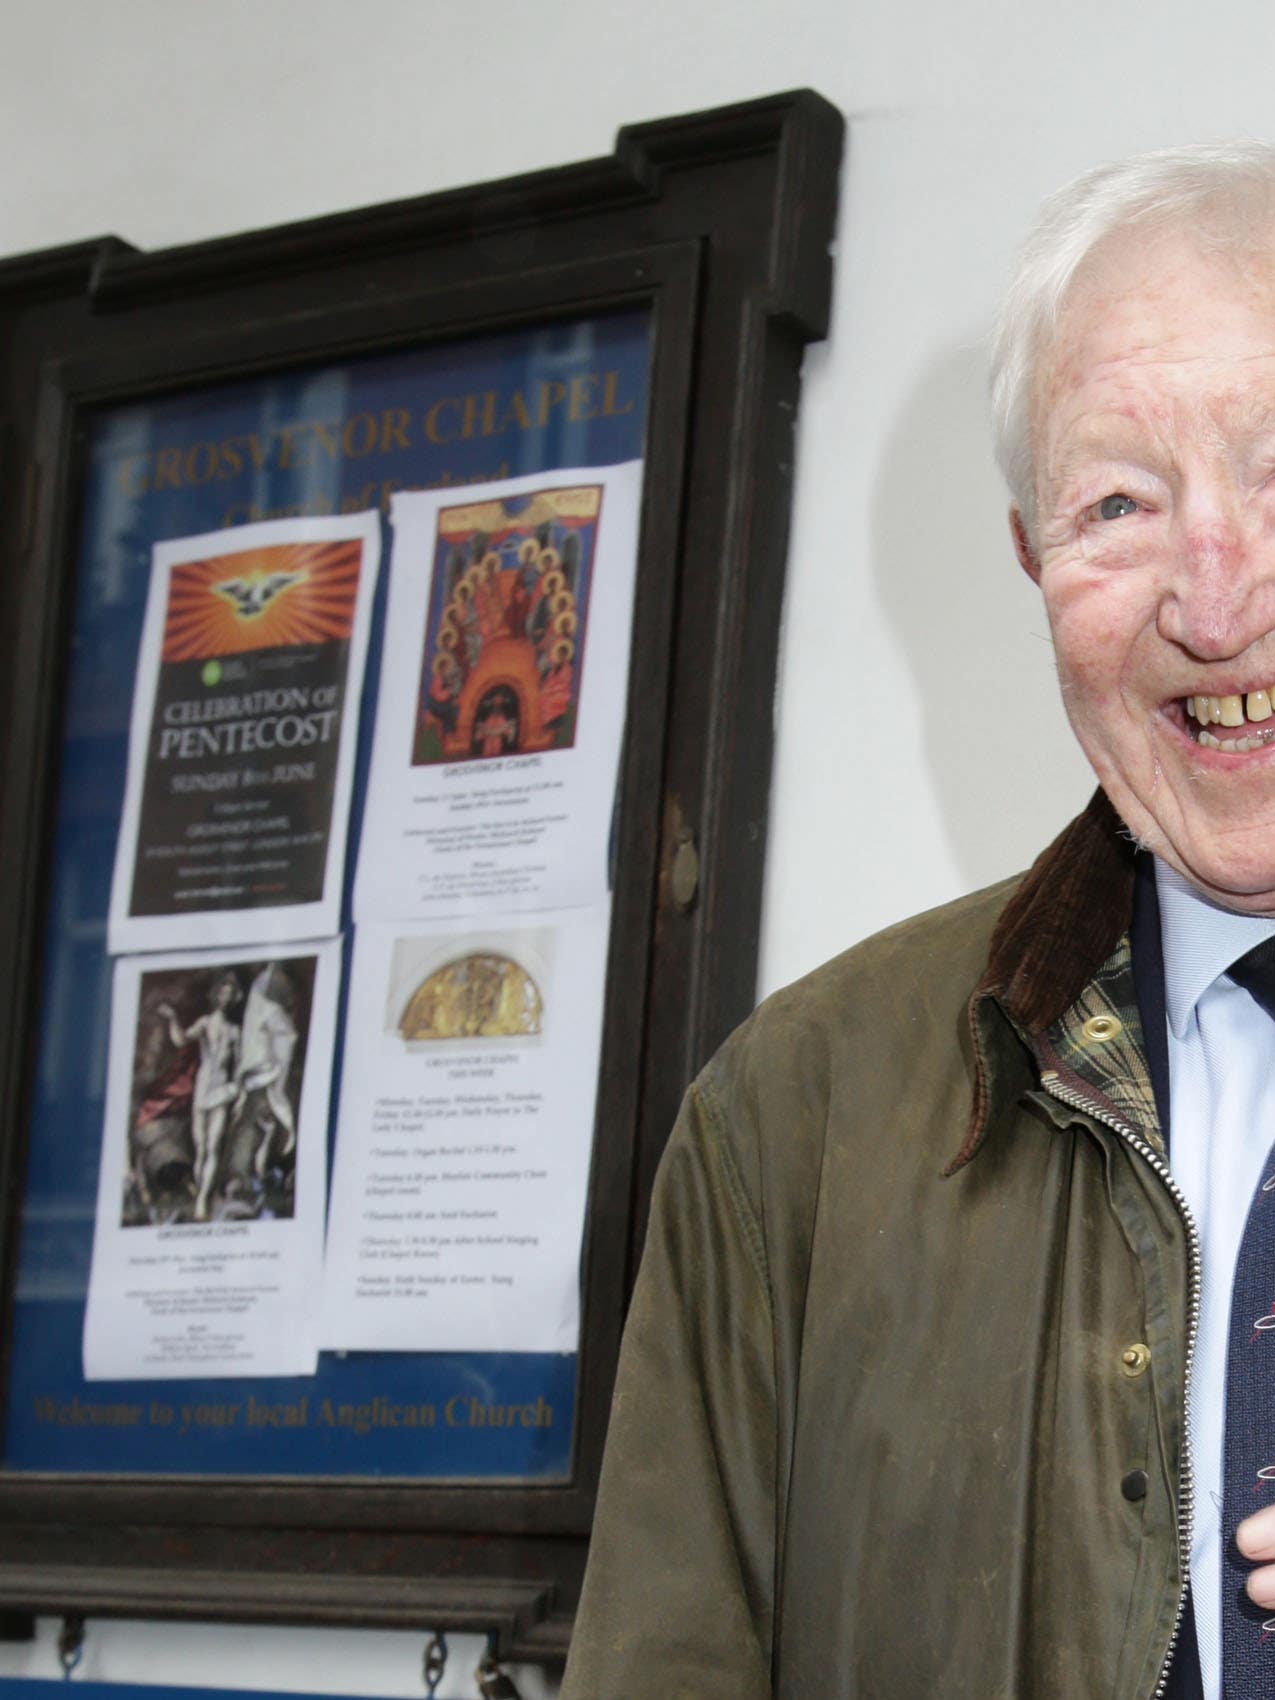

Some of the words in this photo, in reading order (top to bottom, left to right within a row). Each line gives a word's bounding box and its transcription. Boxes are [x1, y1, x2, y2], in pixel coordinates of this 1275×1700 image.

[119, 409, 411, 498] GROSVENOR
[425, 371, 635, 446] CHAPEL
[164, 687, 308, 724] CELEBRATION
[312, 685, 337, 707] OF
[158, 709, 338, 760] PENTECOST
[33, 1394, 142, 1426] Welcome
[150, 1400, 173, 1426] to
[178, 1401, 241, 1435] your
[246, 1395, 307, 1429] local
[318, 1396, 436, 1437] Anglican
[444, 1396, 553, 1428] Church
